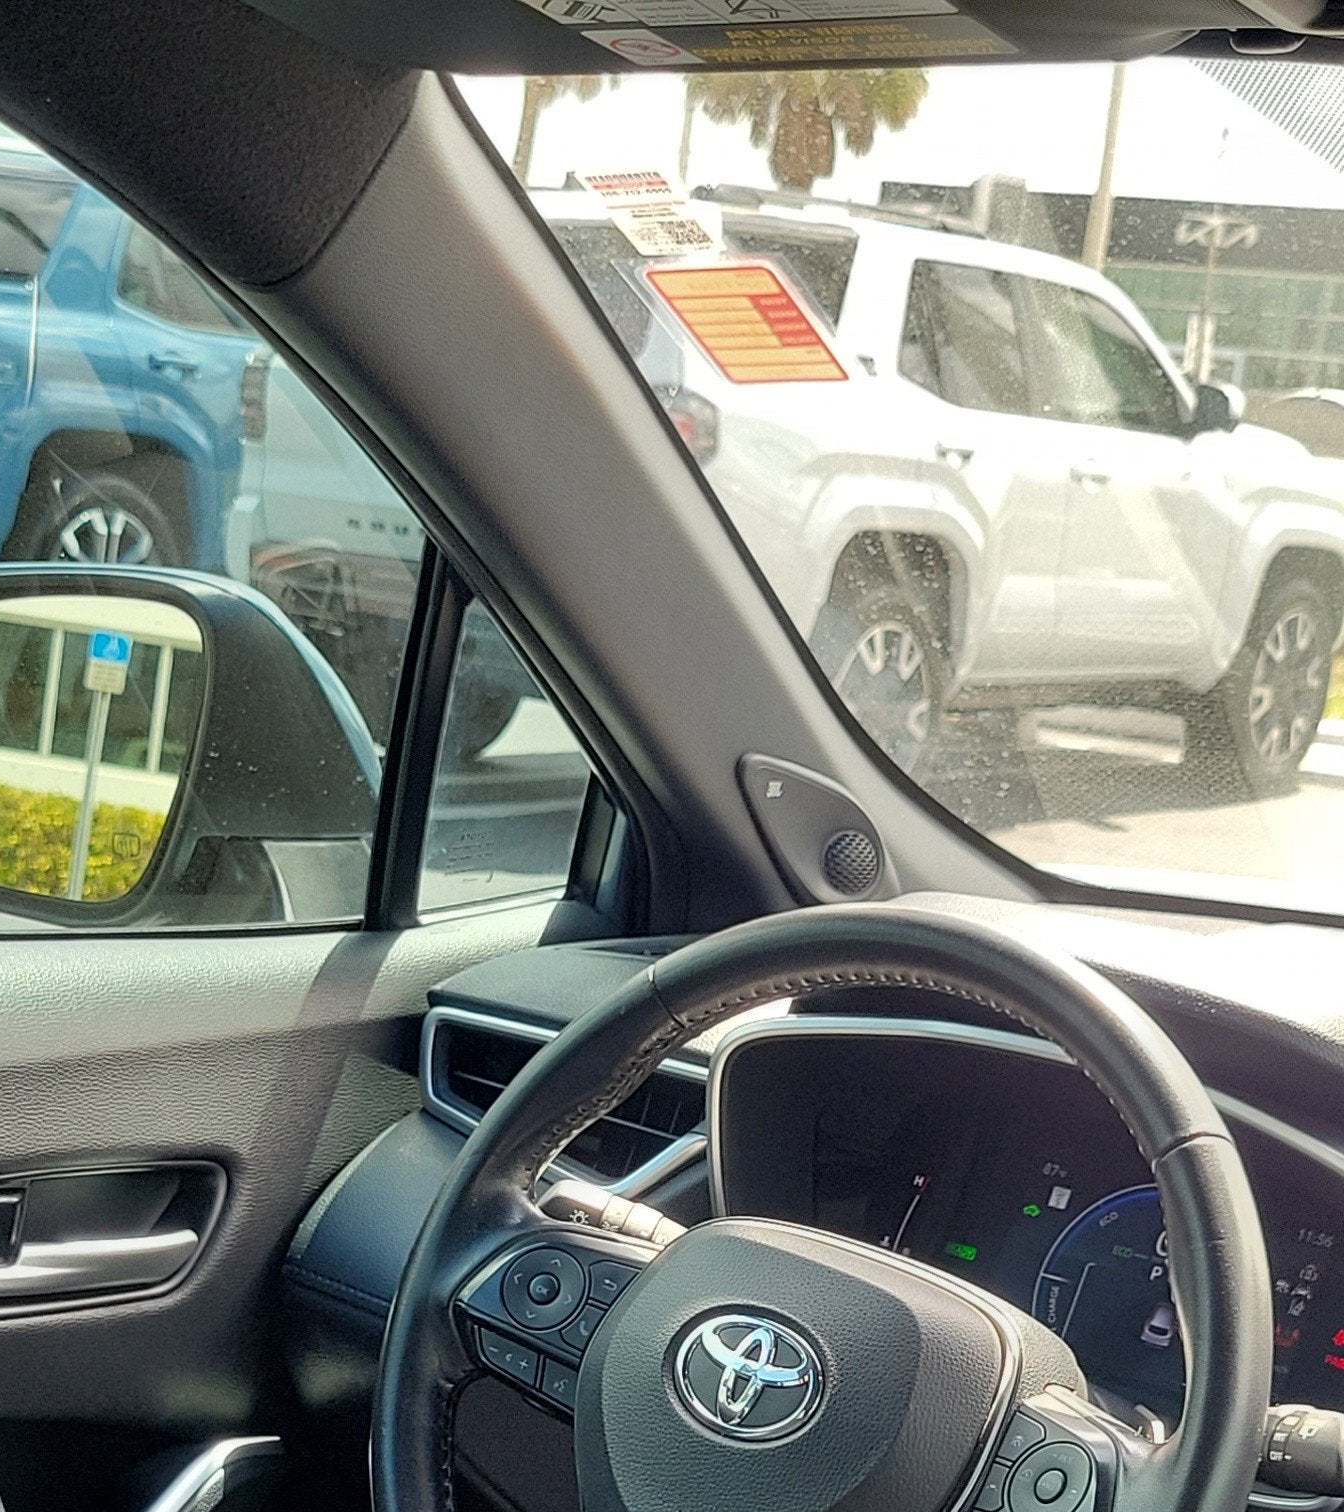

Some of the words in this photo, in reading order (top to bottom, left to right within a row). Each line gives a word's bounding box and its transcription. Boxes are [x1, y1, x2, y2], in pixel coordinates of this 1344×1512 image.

[913, 1174, 924, 1187] H
[1149, 1265, 1164, 1282] P
[535, 1284, 550, 1297] OK
